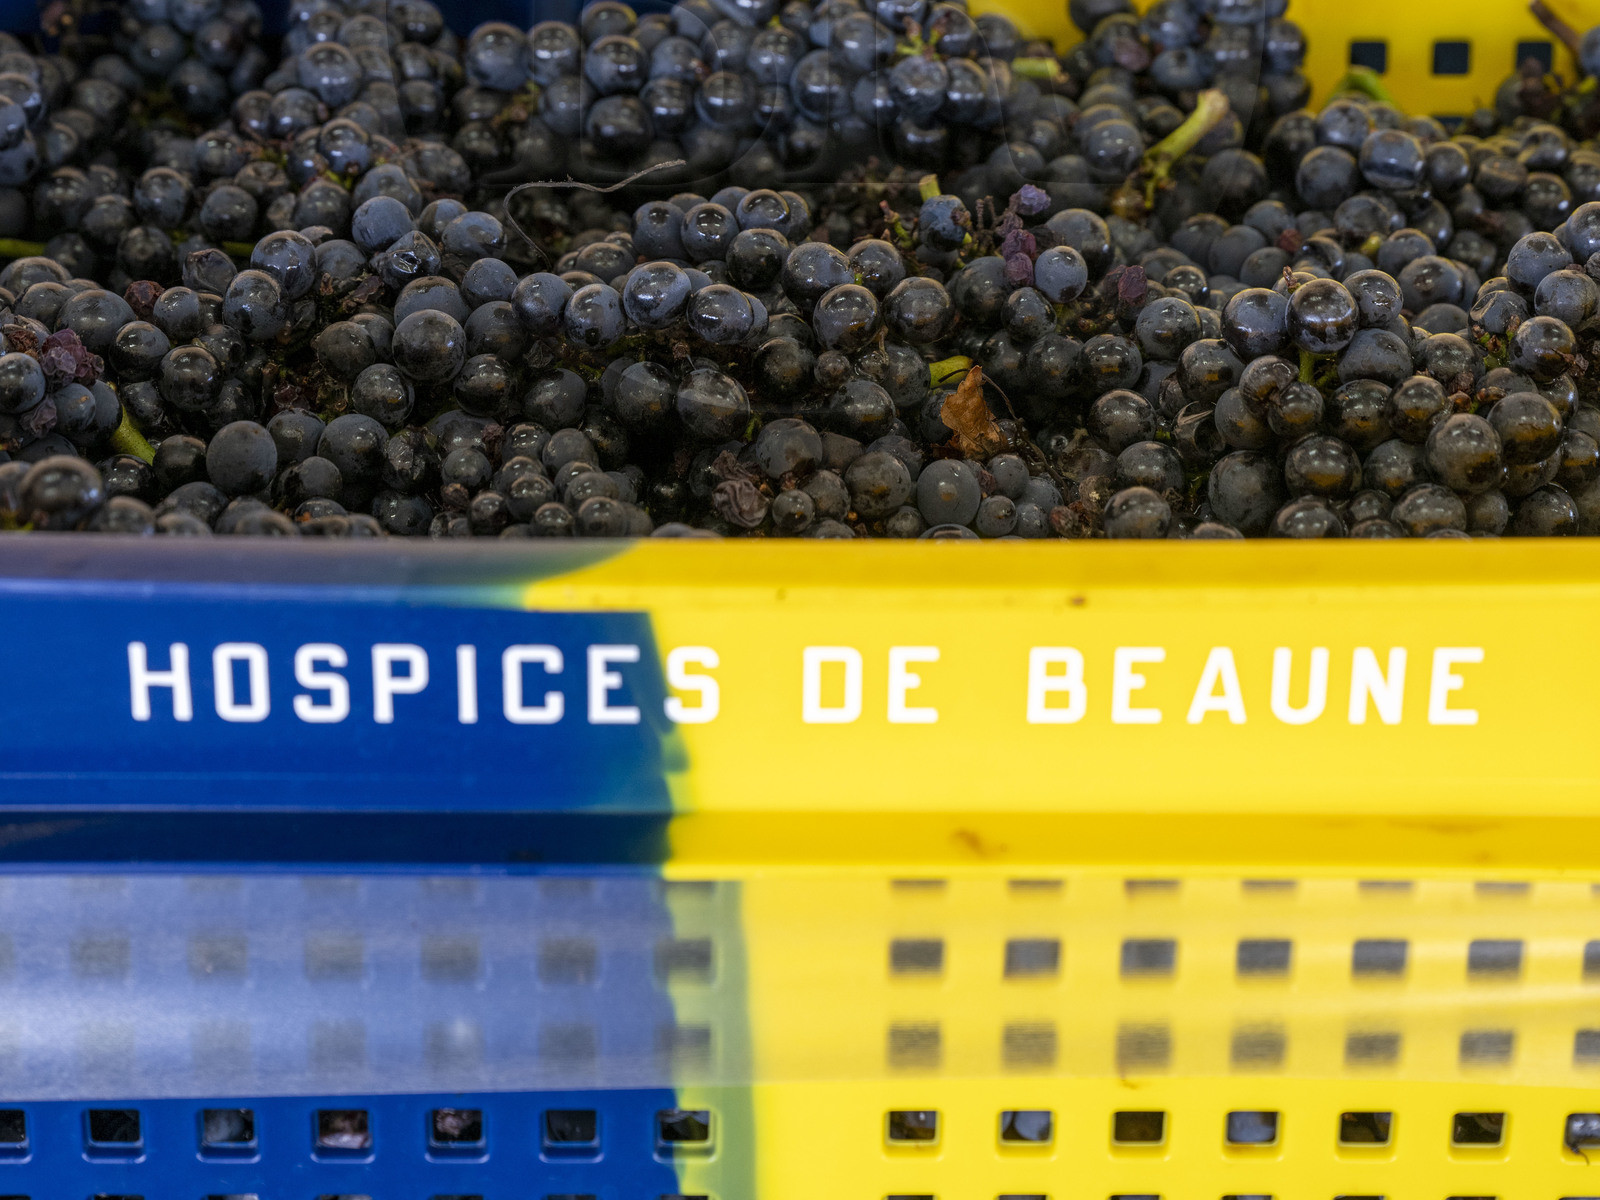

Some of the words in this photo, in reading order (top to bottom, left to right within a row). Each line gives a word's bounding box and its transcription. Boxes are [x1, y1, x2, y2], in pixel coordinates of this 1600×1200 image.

[127, 641, 721, 725] HOSPICES
[801, 645, 941, 725] DE
[1025, 645, 1485, 726] BEAUNE
